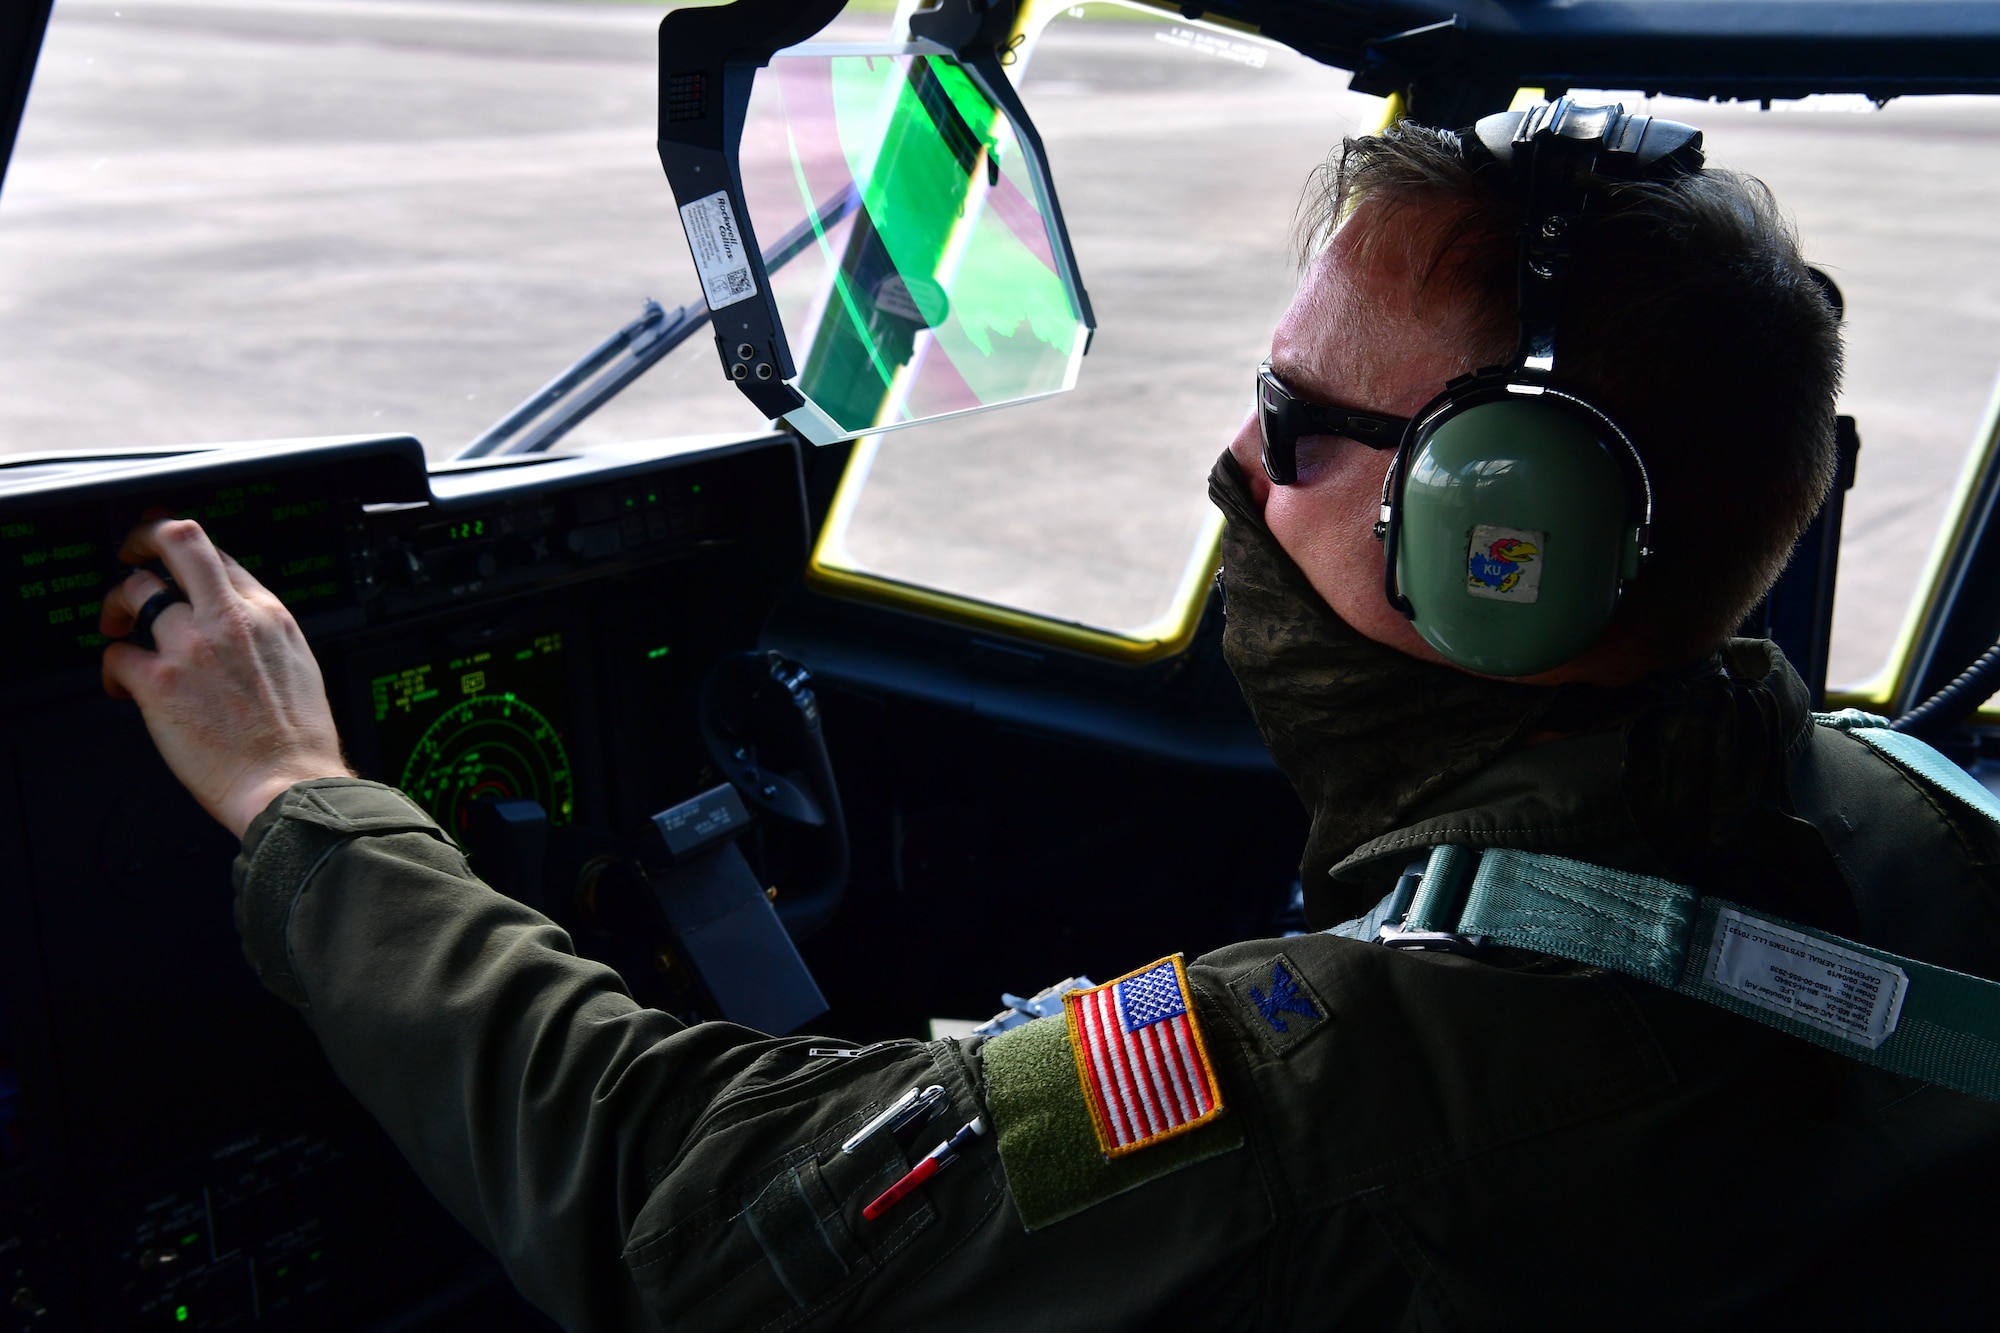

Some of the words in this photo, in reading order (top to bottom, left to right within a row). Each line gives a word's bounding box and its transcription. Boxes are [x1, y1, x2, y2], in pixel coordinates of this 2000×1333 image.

[718, 198, 737, 246] Rockwell
[719, 225, 734, 259] Collins
[450, 519, 485, 541] 122
[1484, 564, 1501, 576] KU
[19, 581, 46, 600] SYS
[1751, 935, 1768, 945] LLC
[1768, 941, 1806, 958] SYSTEMS
[1807, 954, 1836, 969] AERIAL
[1837, 964, 1881, 985] CAPEWELL
[1758, 986, 1793, 1004] Shoulder
[1852, 995, 1875, 1009] Stock
[1820, 1009, 1834, 1019] A/C
[1851, 1012, 1870, 1025] Type
